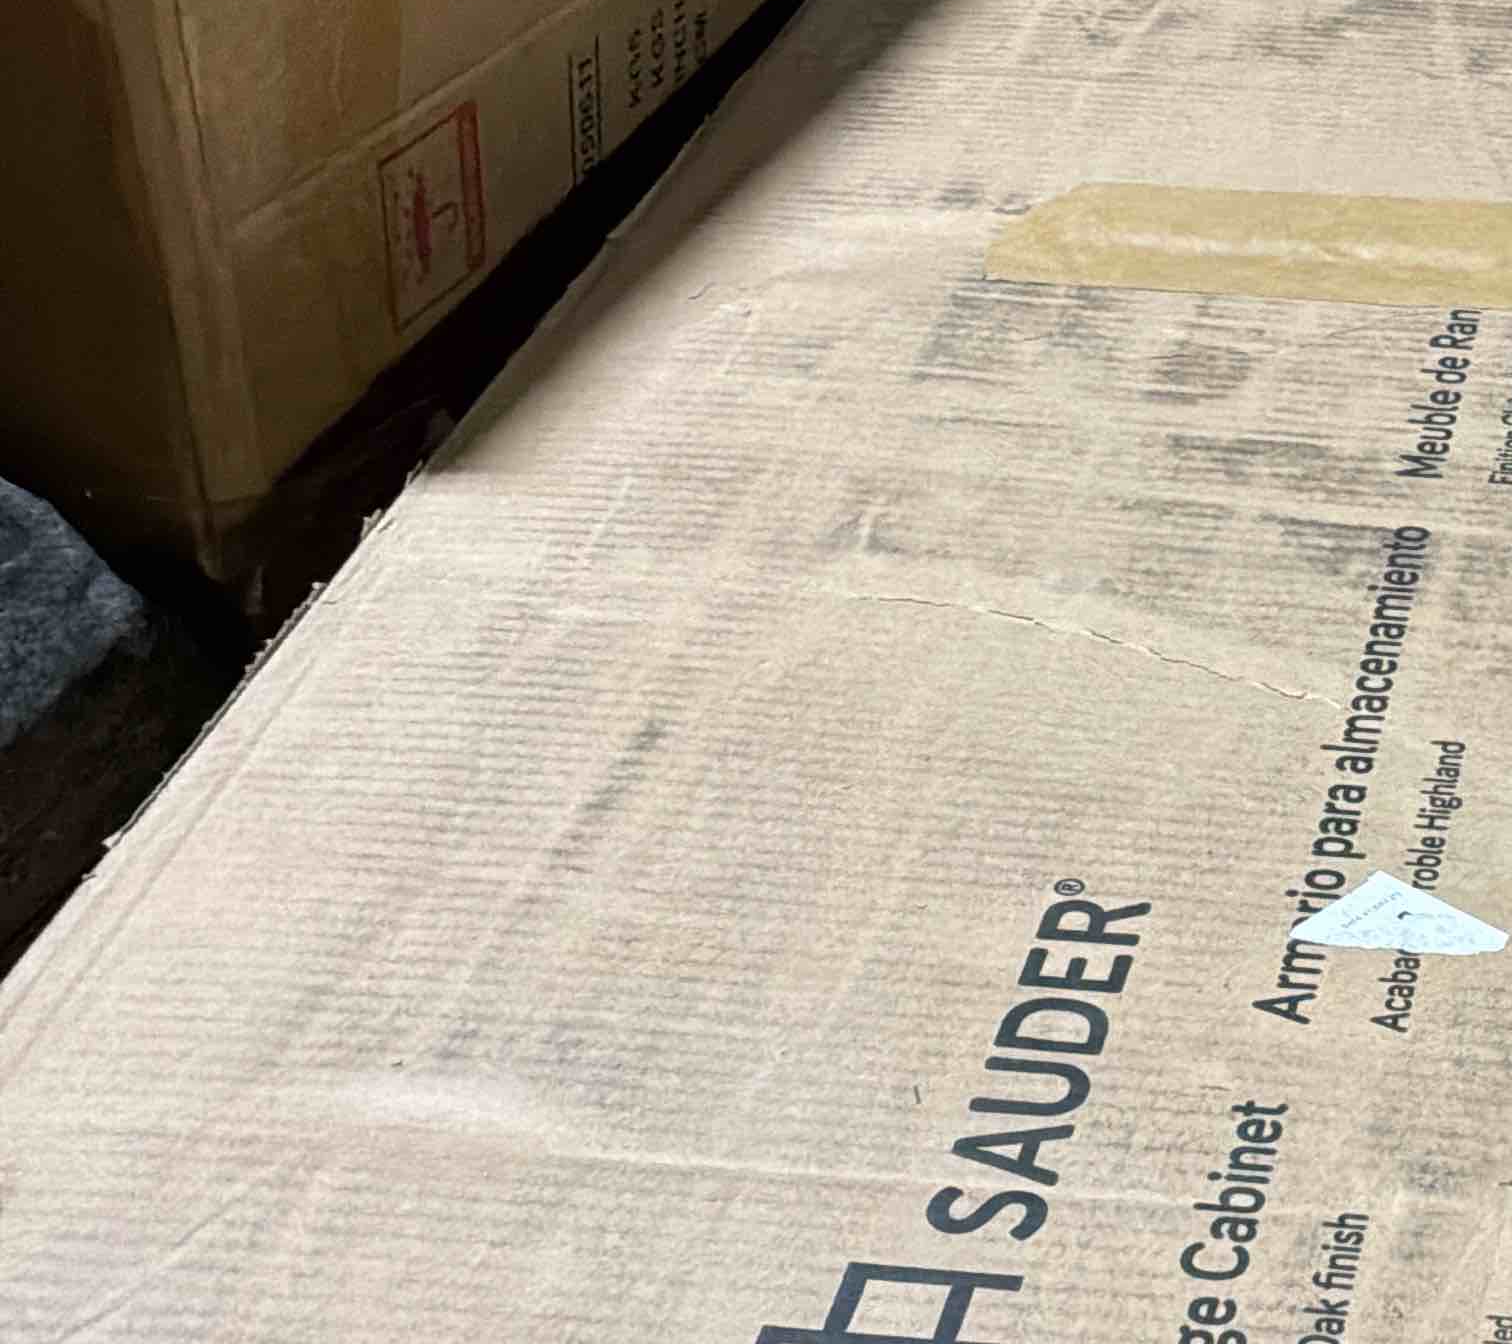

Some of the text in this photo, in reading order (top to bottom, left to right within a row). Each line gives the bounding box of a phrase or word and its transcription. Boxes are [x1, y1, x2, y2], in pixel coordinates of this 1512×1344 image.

[1421, 357, 1470, 385] de
[1394, 390, 1462, 480] Meuble
[1320, 525, 1432, 774] almacenamiento
[1311, 784, 1367, 859] para
[1412, 740, 1466, 831] Highland
[1404, 837, 1446, 890] roble
[1250, 869, 1346, 1025] Armrio
[1179, 1100, 1289, 1281] Cabinet
[1312, 1212, 1369, 1290] finish
